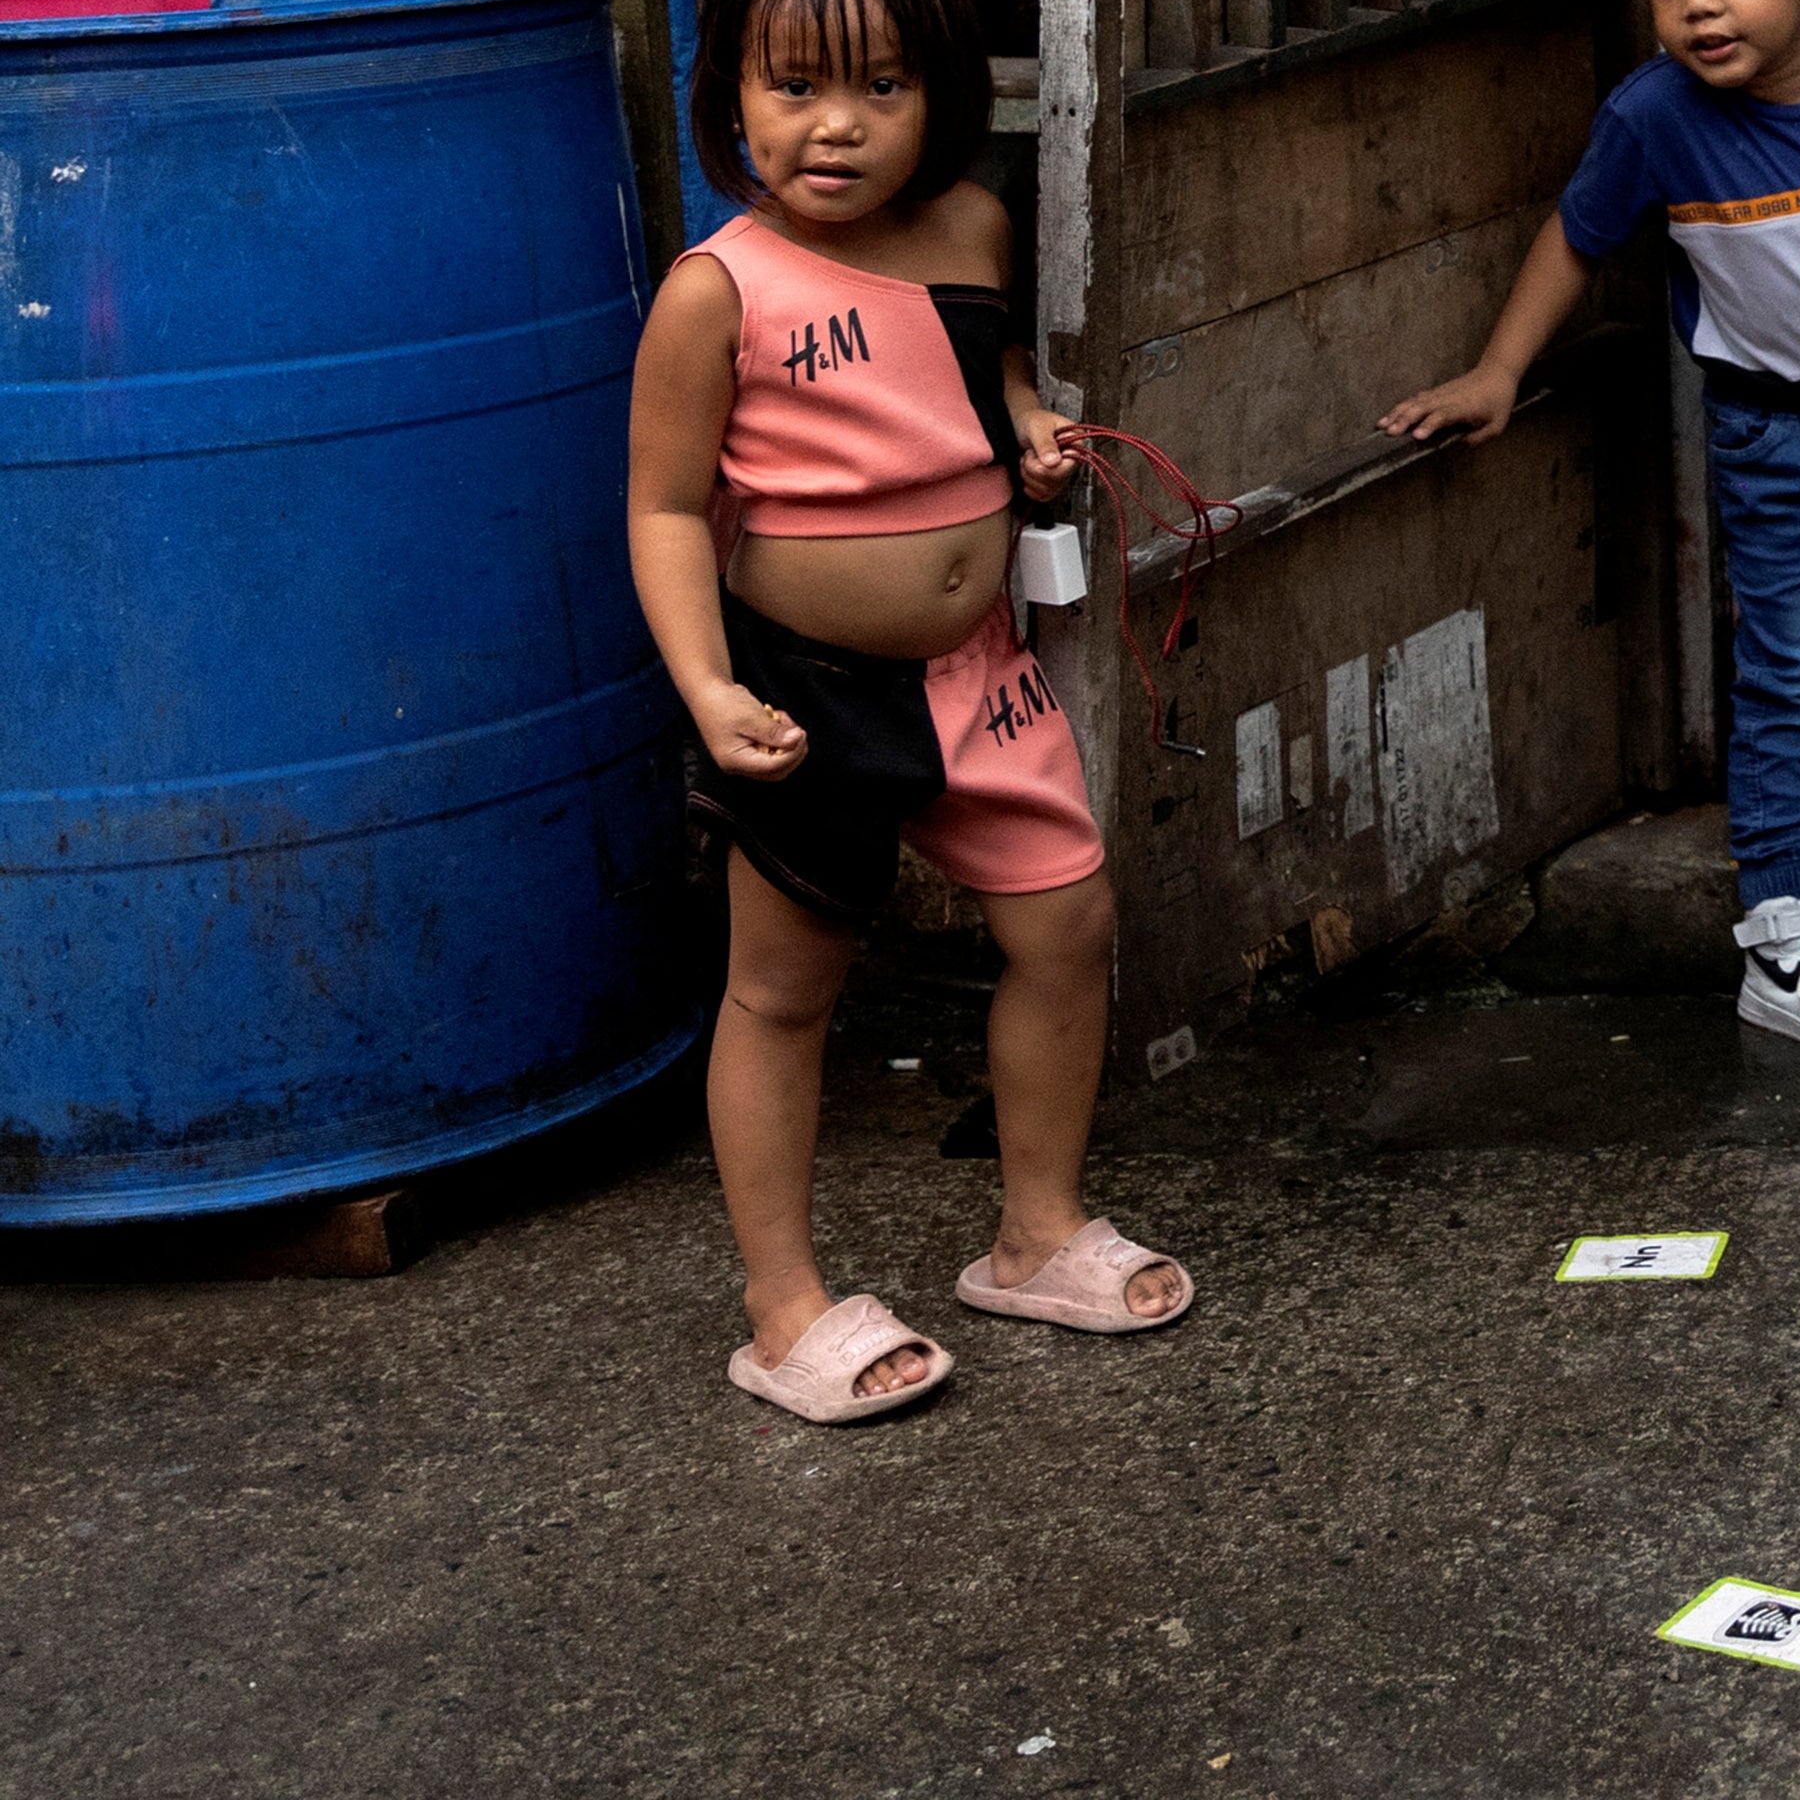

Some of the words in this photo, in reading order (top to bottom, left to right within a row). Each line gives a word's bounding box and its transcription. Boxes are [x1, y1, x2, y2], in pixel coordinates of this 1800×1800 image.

[1756, 198, 1791, 216] 1988
[780, 306, 872, 387] H&M
[985, 662, 1059, 749] H&M
